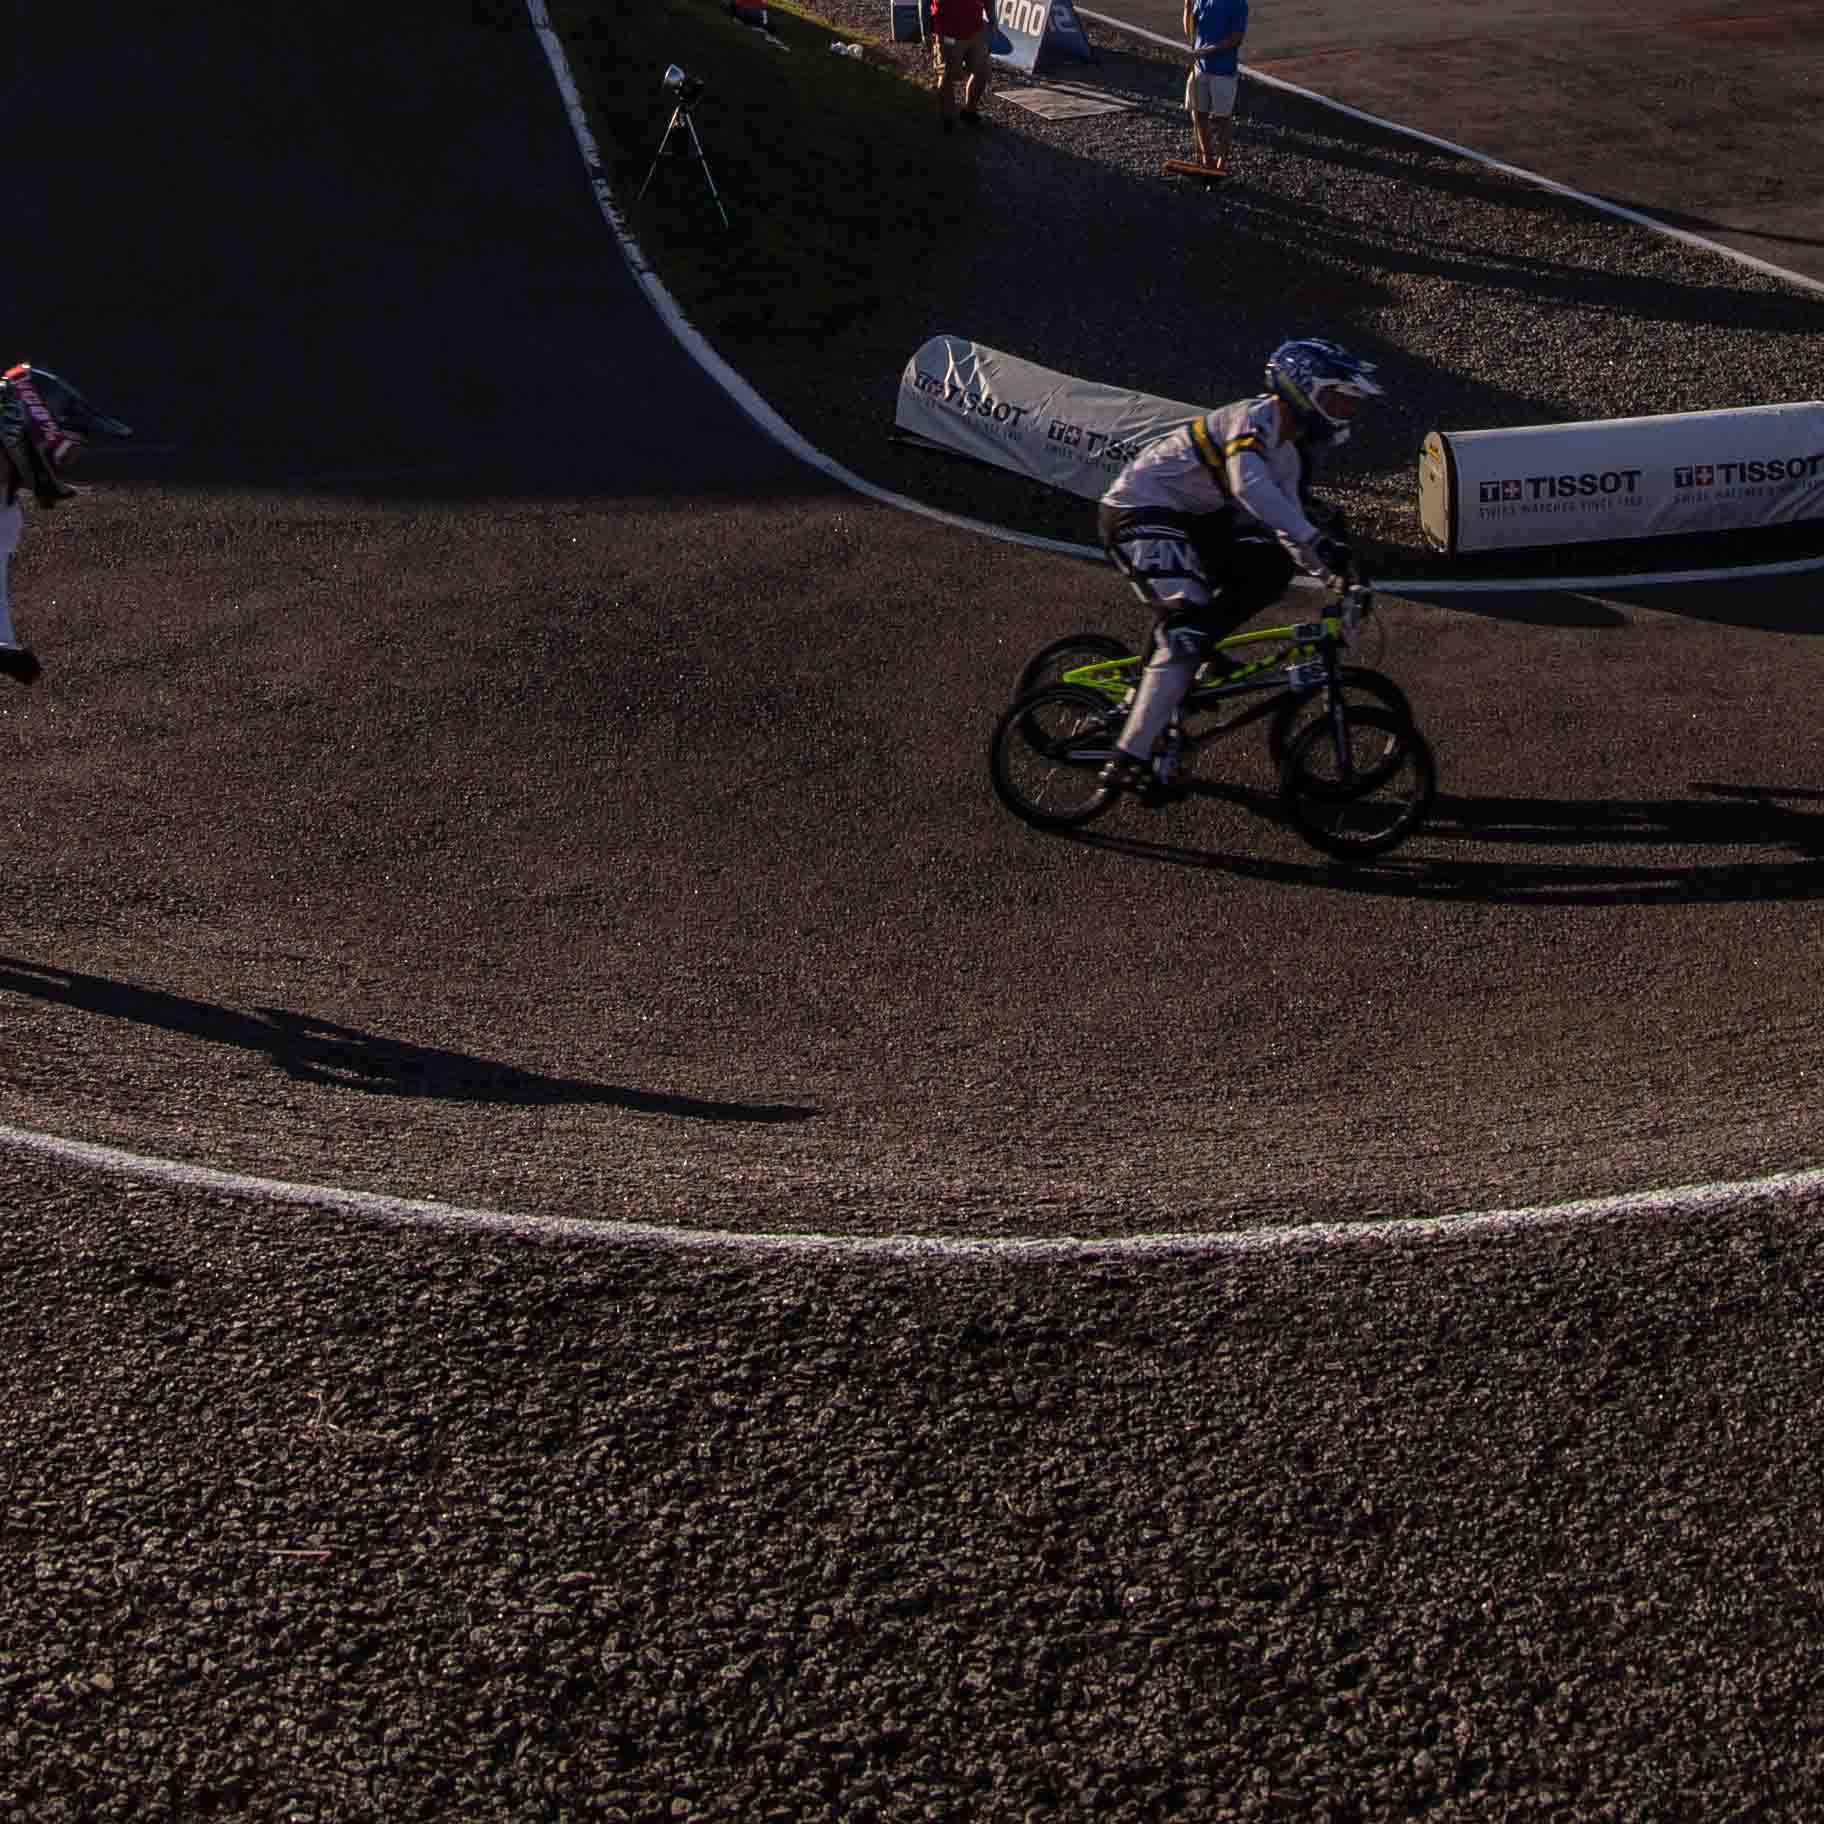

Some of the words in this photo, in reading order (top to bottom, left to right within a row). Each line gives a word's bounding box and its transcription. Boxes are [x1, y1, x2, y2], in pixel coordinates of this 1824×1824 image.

[945, 383, 1027, 426] TISSOT
[1716, 454, 1824, 484] TISSOT
[1526, 470, 1641, 499] TISSOT
